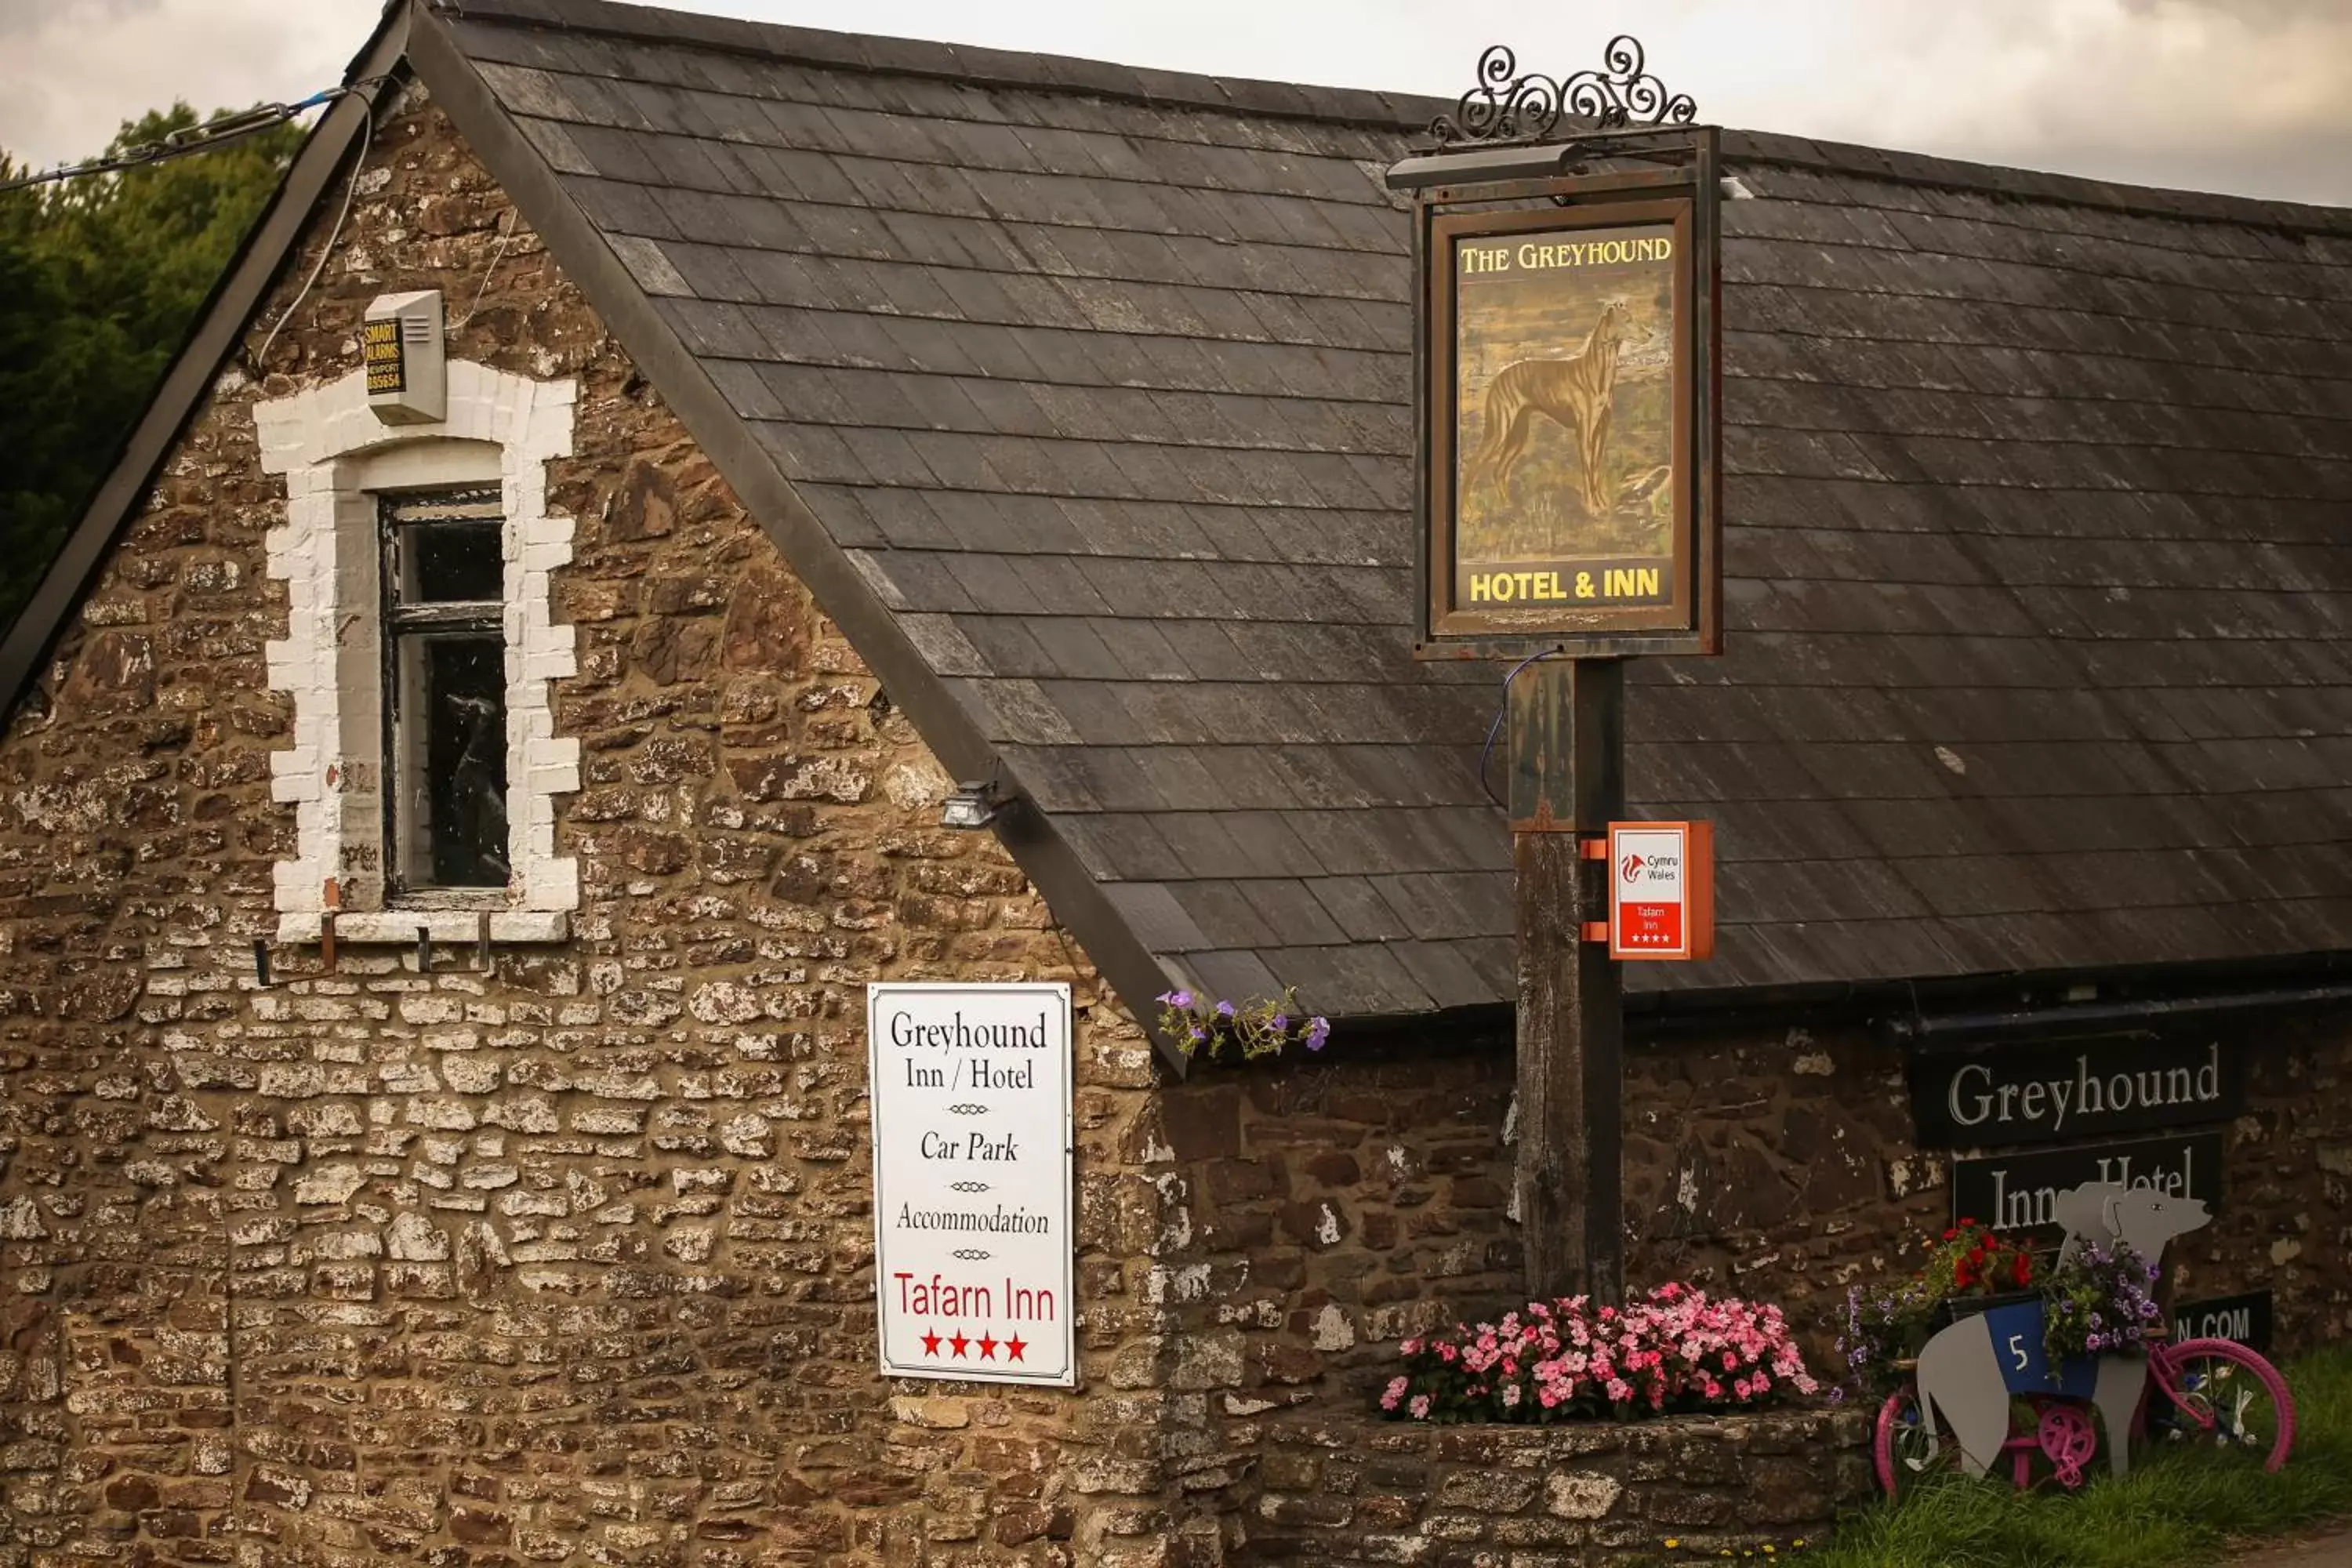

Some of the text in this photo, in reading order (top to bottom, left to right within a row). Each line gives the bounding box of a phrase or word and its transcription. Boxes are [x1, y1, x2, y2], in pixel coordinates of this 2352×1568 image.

[1461, 238, 1672, 274] THE GREYHOUND
[365, 324, 397, 343] SMART
[365, 343, 399, 361] ALARMS
[1470, 568, 1659, 602] HOTEL & INN
[1647, 855, 1679, 869] Cymru
[1647, 869, 1675, 880] Wales
[891, 1011, 1047, 1055] Greyhound
[906, 1058, 943, 1088] Inn
[971, 1058, 1033, 1089] Hotel
[1948, 1042, 2220, 1131] Greyhound
[921, 1131, 1018, 1162] Car Park
[1991, 1170, 2058, 1231] Inn
[897, 1202, 1050, 1235] Accommodation
[894, 1272, 1054, 1321] Tafarn Inn
[2009, 1334, 2029, 1371] 5
